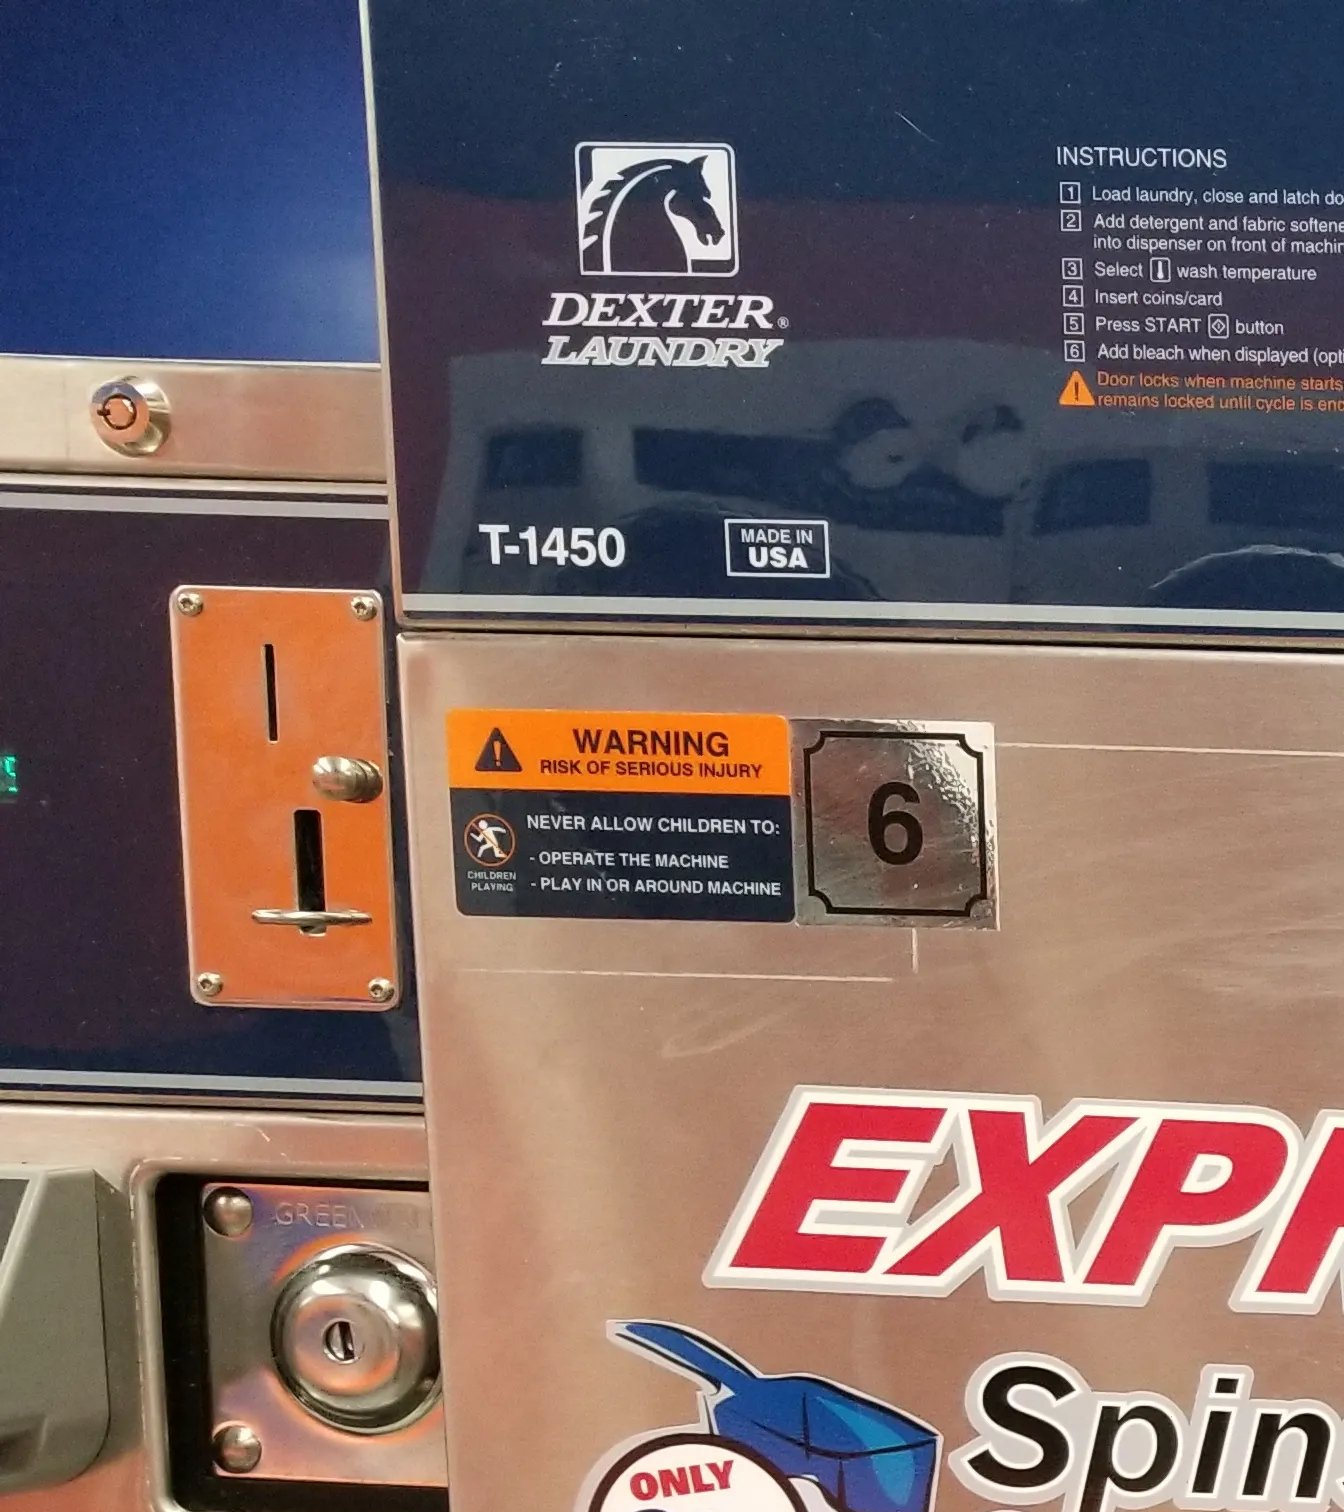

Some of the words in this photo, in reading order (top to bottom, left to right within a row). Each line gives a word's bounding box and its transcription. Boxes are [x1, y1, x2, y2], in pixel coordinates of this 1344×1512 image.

[1056, 146, 1227, 169] INSTRUCTIONS
[1092, 187, 1130, 203] Load
[1135, 188, 1198, 206] laundry,
[1203, 190, 1243, 204] close
[1249, 190, 1278, 204] and
[1283, 190, 1319, 204] latch
[1094, 215, 1125, 229] Add
[1129, 216, 1203, 233] detergent
[1209, 217, 1238, 231] and
[1243, 217, 1285, 232] fabric
[1093, 235, 1121, 250] into
[1126, 236, 1201, 254] dispenser
[1207, 240, 1226, 252] on
[1231, 238, 1266, 252] front
[1271, 239, 1287, 253] of
[1094, 262, 1143, 277] Select
[1177, 265, 1217, 279] wash
[1222, 265, 1317, 282] temperature
[1095, 289, 1138, 305] Insert
[1142, 291, 1222, 306] coins/card
[542, 292, 775, 329] DEXTER
[1096, 317, 1140, 332] Press
[1145, 318, 1201, 333] START
[1236, 320, 1283, 335] button
[542, 336, 783, 368] LAUNDRY
[1098, 344, 1128, 360] Add
[1133, 345, 1184, 361] bleach
[1189, 347, 1229, 362] when
[1235, 347, 1308, 365] displayed
[1097, 371, 1134, 386] Door
[1139, 372, 1179, 387] locks
[1184, 374, 1225, 389] when
[1230, 375, 1295, 390] machine
[479, 523, 626, 567] T-1450
[741, 528, 791, 544] MADE
[796, 529, 813, 544] IN
[748, 548, 808, 569] USA
[573, 729, 729, 758] WARNING
[540, 759, 582, 774] RISK
[586, 760, 611, 775] OF
[616, 760, 693, 776] SERIOUS
[700, 762, 762, 778] INJURY
[527, 815, 586, 831] NEVER
[591, 816, 653, 833] ALLOW
[657, 818, 746, 834] CHILDREN
[751, 820, 780, 835] TO:
[867, 782, 923, 865] 6
[539, 851, 615, 867] OPERATE
[618, 853, 651, 867] THE
[655, 854, 729, 869] MACHINE
[467, 870, 516, 880] CHILDREN
[471, 882, 514, 891] PLAYING
[540, 878, 582, 893] PLAY
[586, 878, 601, 893] IN
[606, 879, 629, 894] OR
[635, 879, 703, 895] AROUND
[707, 880, 781, 897] MACHINE
[630, 1460, 734, 1500] ONLY
